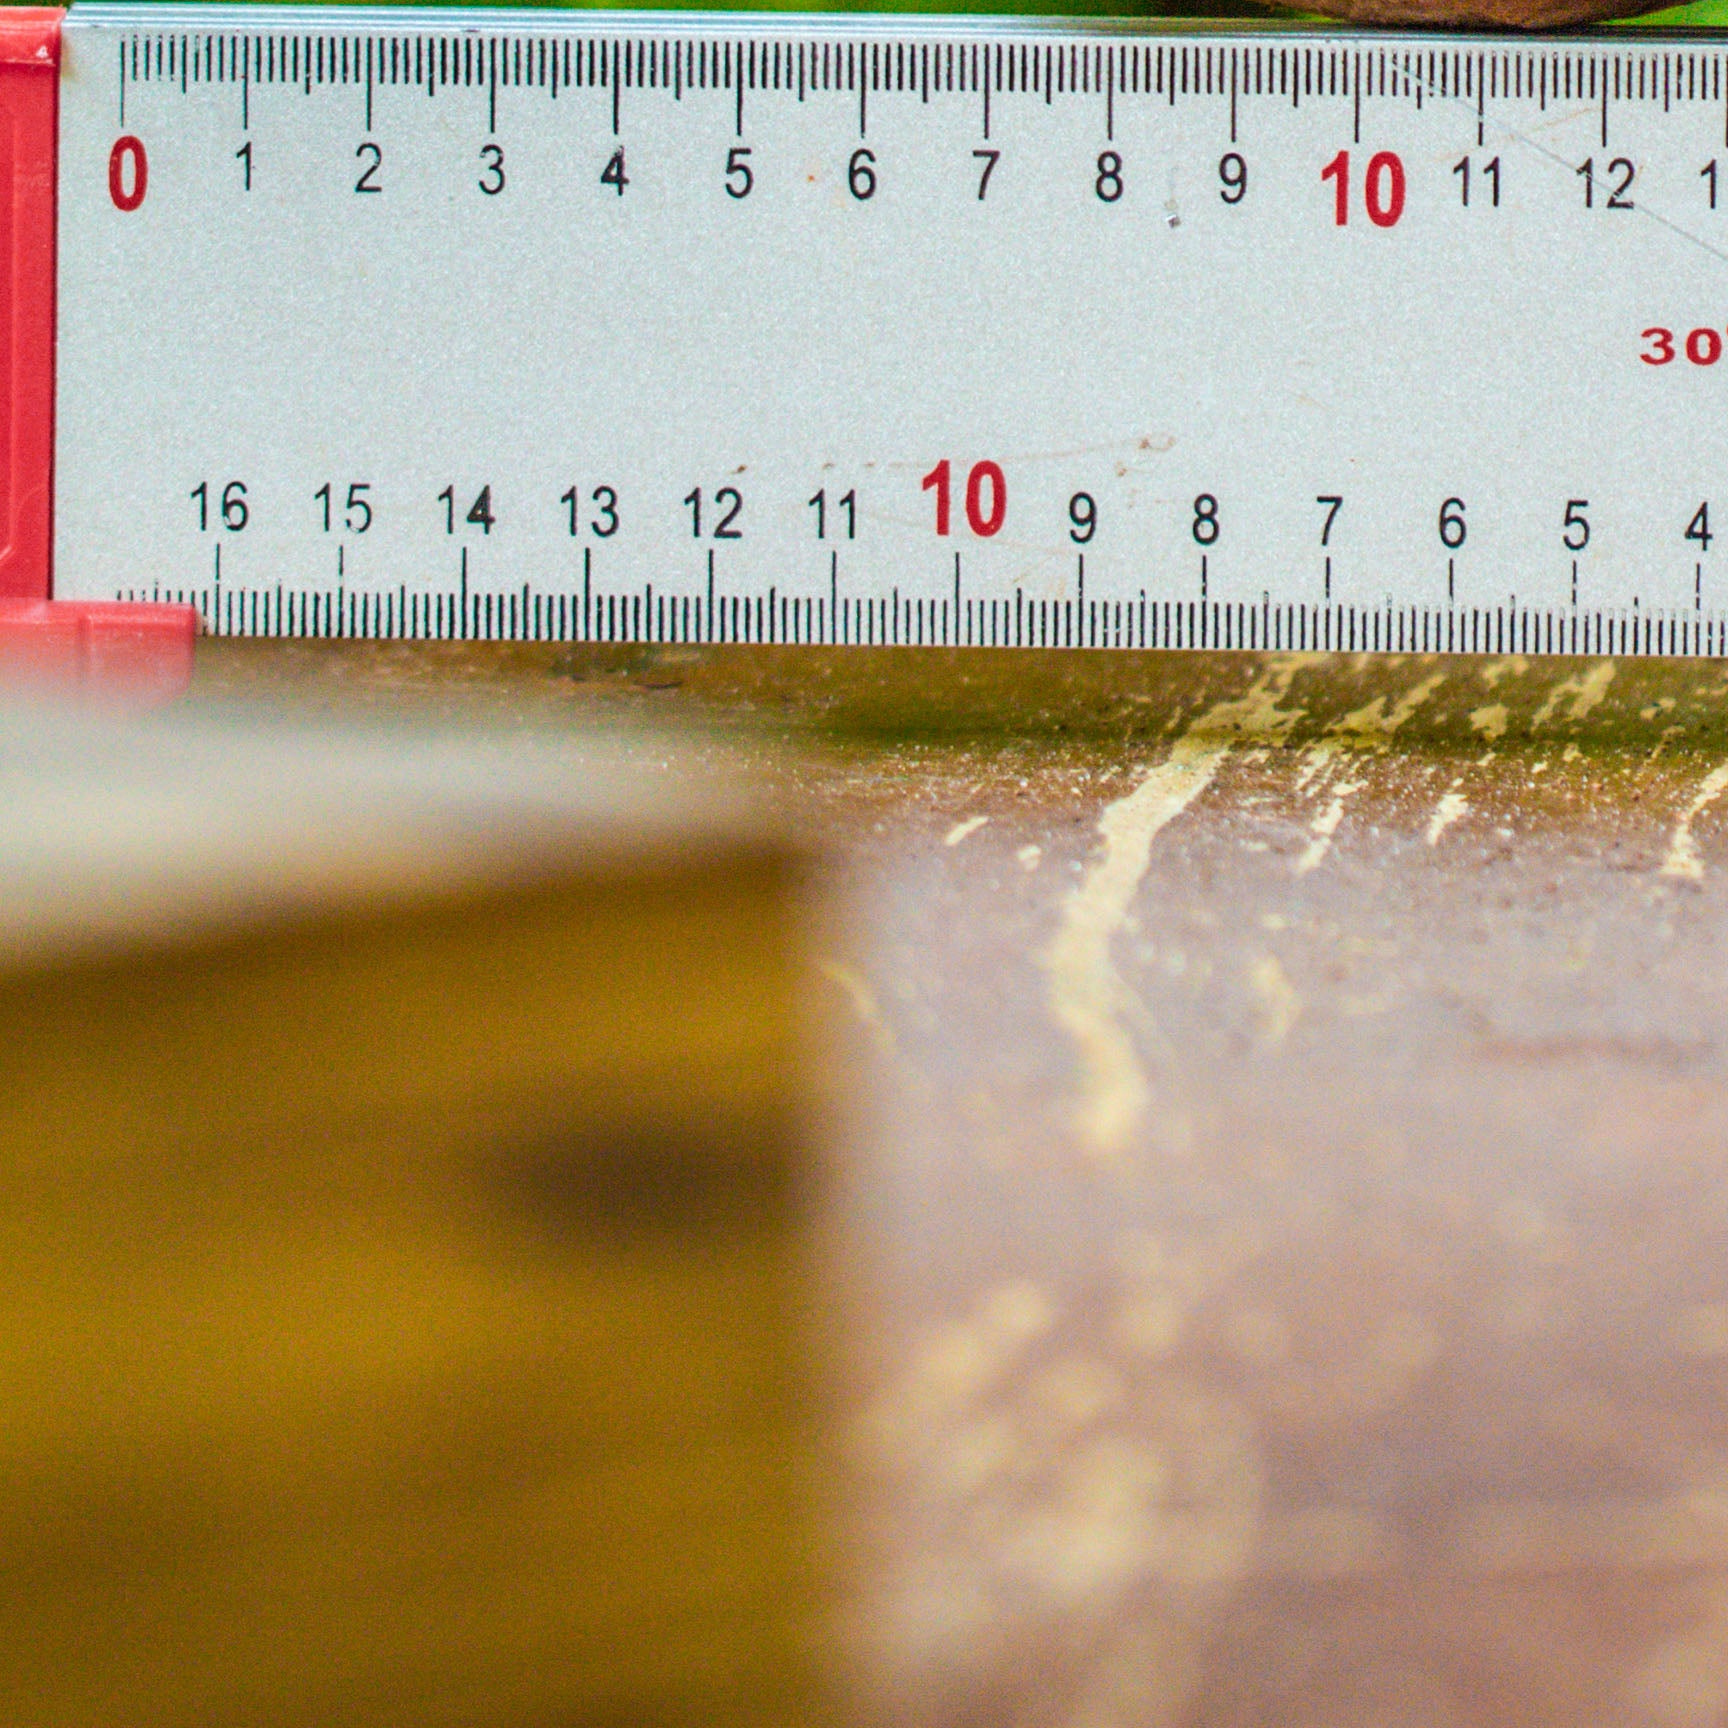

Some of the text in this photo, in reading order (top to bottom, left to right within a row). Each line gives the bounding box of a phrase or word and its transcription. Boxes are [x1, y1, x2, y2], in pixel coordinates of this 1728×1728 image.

[109, 136, 148, 212] 0
[236, 141, 255, 191] 1
[355, 142, 382, 193] 2
[479, 144, 505, 195] 3
[601, 145, 630, 196] 4
[725, 147, 754, 199] 5
[848, 148, 877, 200] 6
[972, 150, 1000, 200] 7
[1095, 150, 1124, 202] 8
[1219, 153, 1247, 204] 9
[1321, 150, 1406, 228] 10
[1453, 156, 1500, 207] 11
[1576, 157, 1636, 209] 12
[191, 481, 249, 531] 16
[315, 482, 372, 533] 15
[438, 485, 496, 534] 14
[561, 485, 619, 537] 13
[684, 487, 743, 539] 12
[809, 488, 855, 539] 11
[922, 460, 1007, 537] 10
[1069, 492, 1097, 544] 9
[1192, 493, 1220, 545] 8
[1316, 496, 1343, 546] 7
[1439, 497, 1466, 549] 6
[1563, 499, 1590, 551] 5
[1684, 501, 1713, 551] 4
